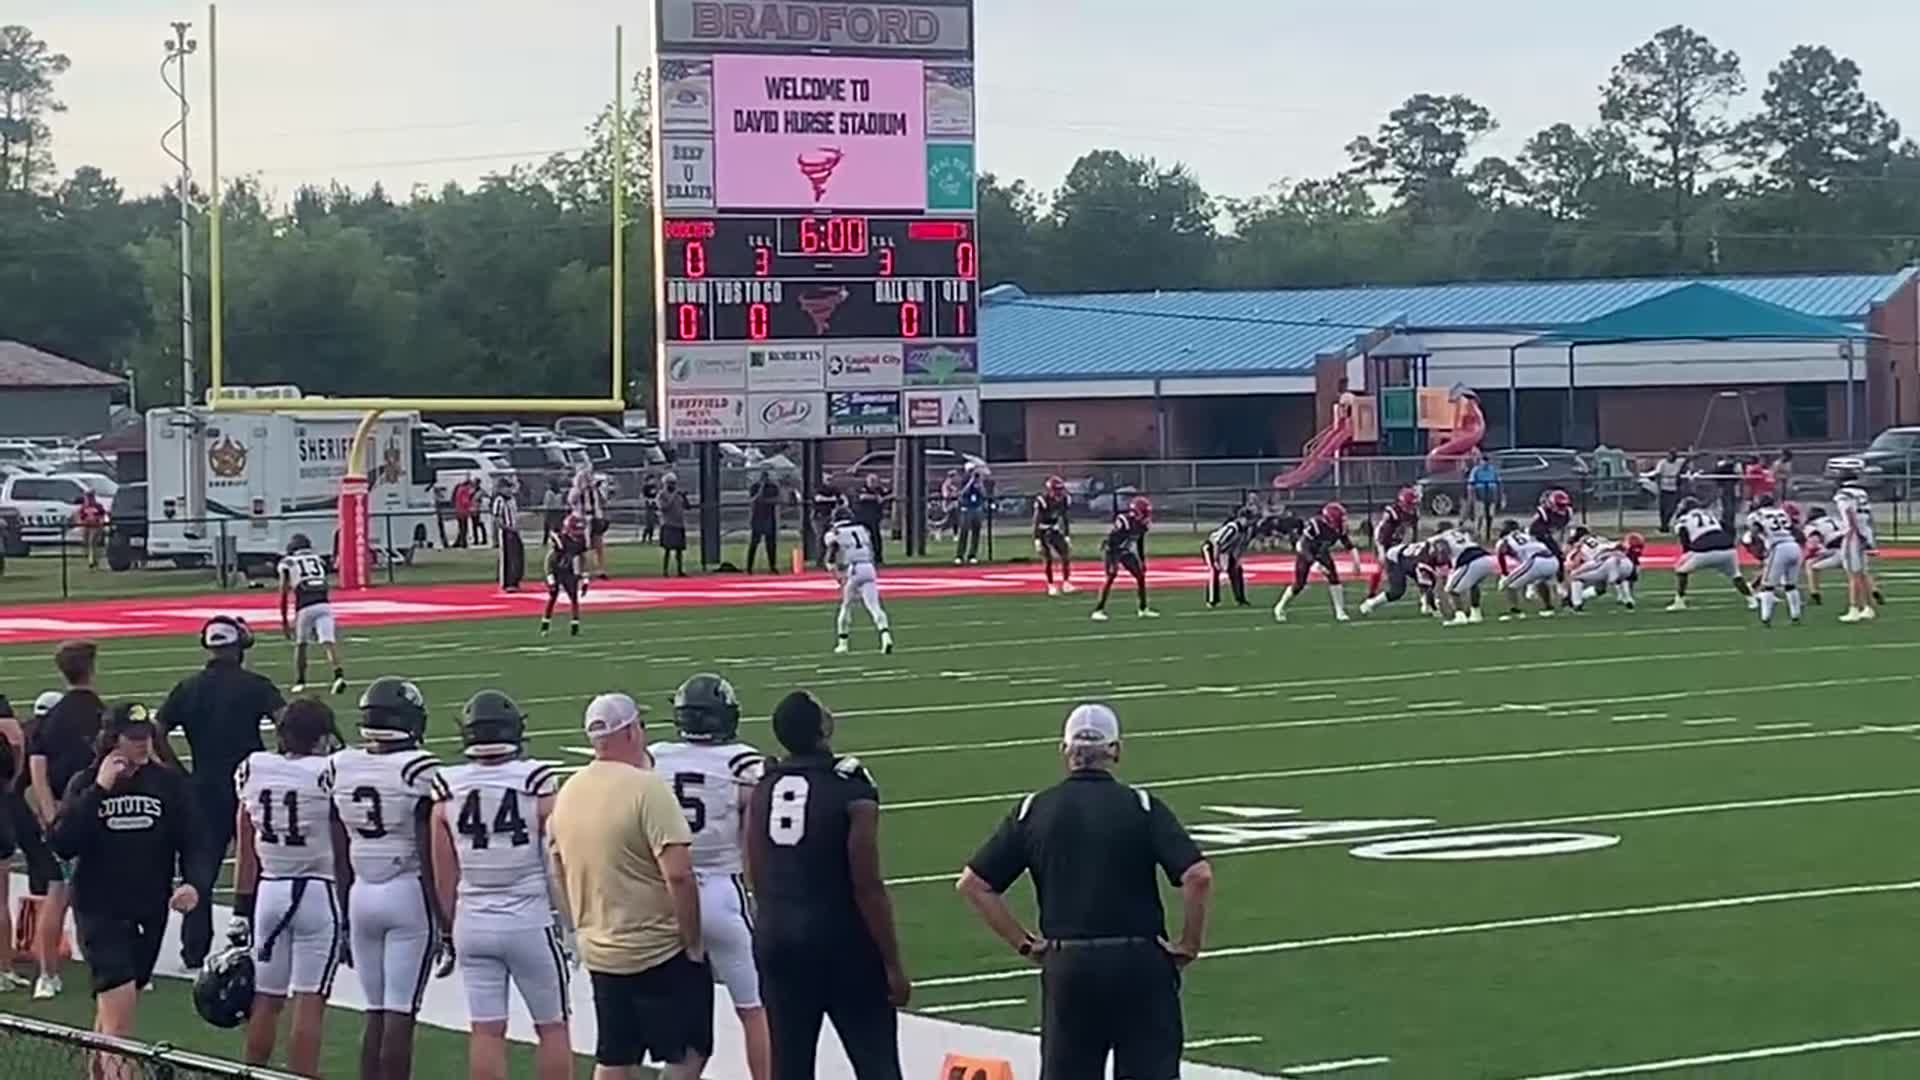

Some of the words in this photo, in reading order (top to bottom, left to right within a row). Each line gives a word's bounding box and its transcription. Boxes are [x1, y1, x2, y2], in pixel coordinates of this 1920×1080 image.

[692, 2, 940, 45] BRADFORD
[765, 76, 845, 100] WELCOME
[850, 79, 870, 101] TO
[733, 110, 778, 133] DAVID
[784, 111, 834, 134] HURSE
[839, 112, 907, 136] STADIUM
[801, 217, 863, 252] 6:00
[686, 242, 704, 277] 0
[755, 248, 768, 275] 3
[879, 248, 892, 275] 3
[957, 242, 973, 277] 0
[667, 281, 707, 304] DOWN
[680, 303, 697, 339] 0
[750, 303, 767, 339] 0
[901, 302, 918, 337] 0
[958, 304, 965, 334] 1
[882, 354, 901, 365] City
[851, 531, 864, 549] 1
[297, 558, 321, 577] 13
[258, 788, 307, 847] 11
[352, 786, 388, 839] 3
[457, 787, 530, 850] 44
[674, 771, 706, 834] 5
[768, 775, 810, 846] 8
